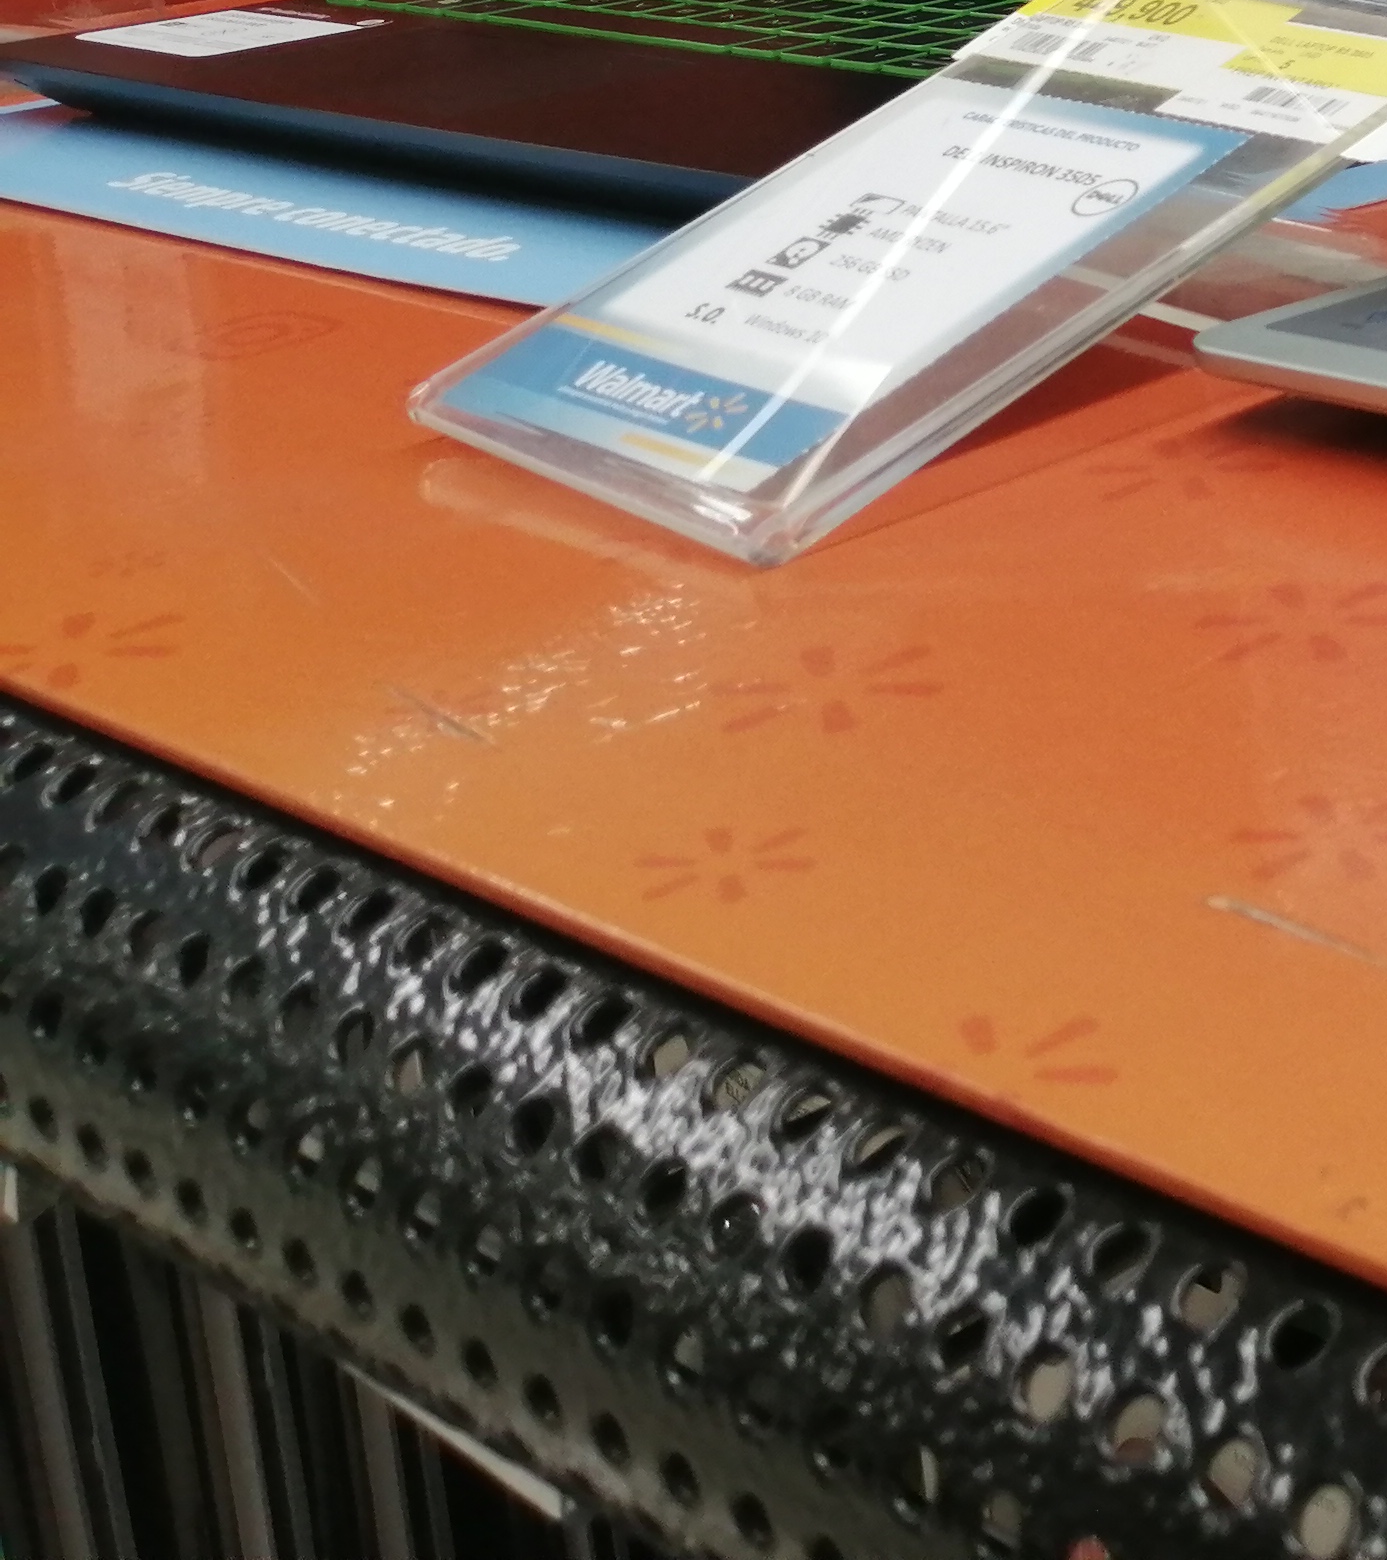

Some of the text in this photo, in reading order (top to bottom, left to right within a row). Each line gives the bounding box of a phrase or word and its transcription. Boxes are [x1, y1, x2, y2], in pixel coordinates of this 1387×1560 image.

[980, 154, 1059, 178] INSPIRON
[1056, 169, 1102, 186] 3505
[107, 171, 295, 216] Siempre
[574, 360, 705, 418] Walmart
